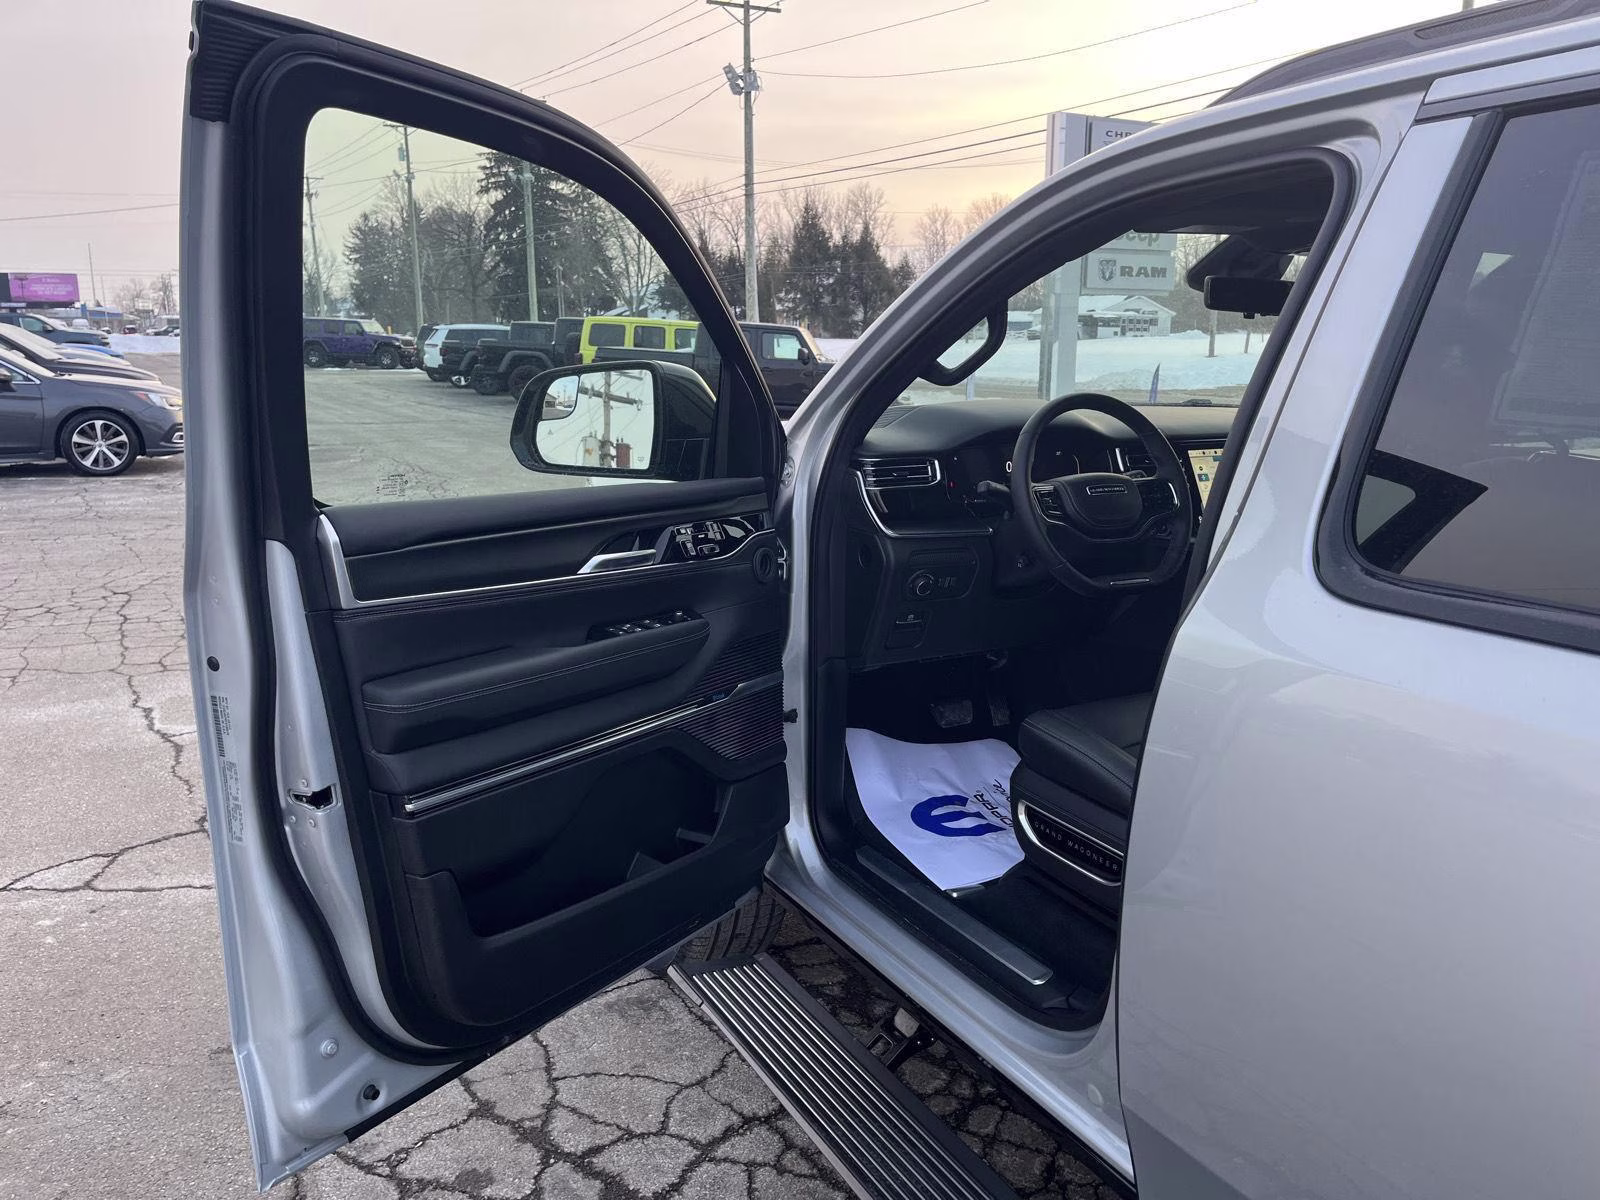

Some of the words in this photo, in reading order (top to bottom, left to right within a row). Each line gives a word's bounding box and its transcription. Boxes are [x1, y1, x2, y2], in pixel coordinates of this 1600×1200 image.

[1119, 265, 1168, 278] RAM
[1034, 821, 1063, 840] GRAND
[1067, 839, 1118, 872] WAGONEER
